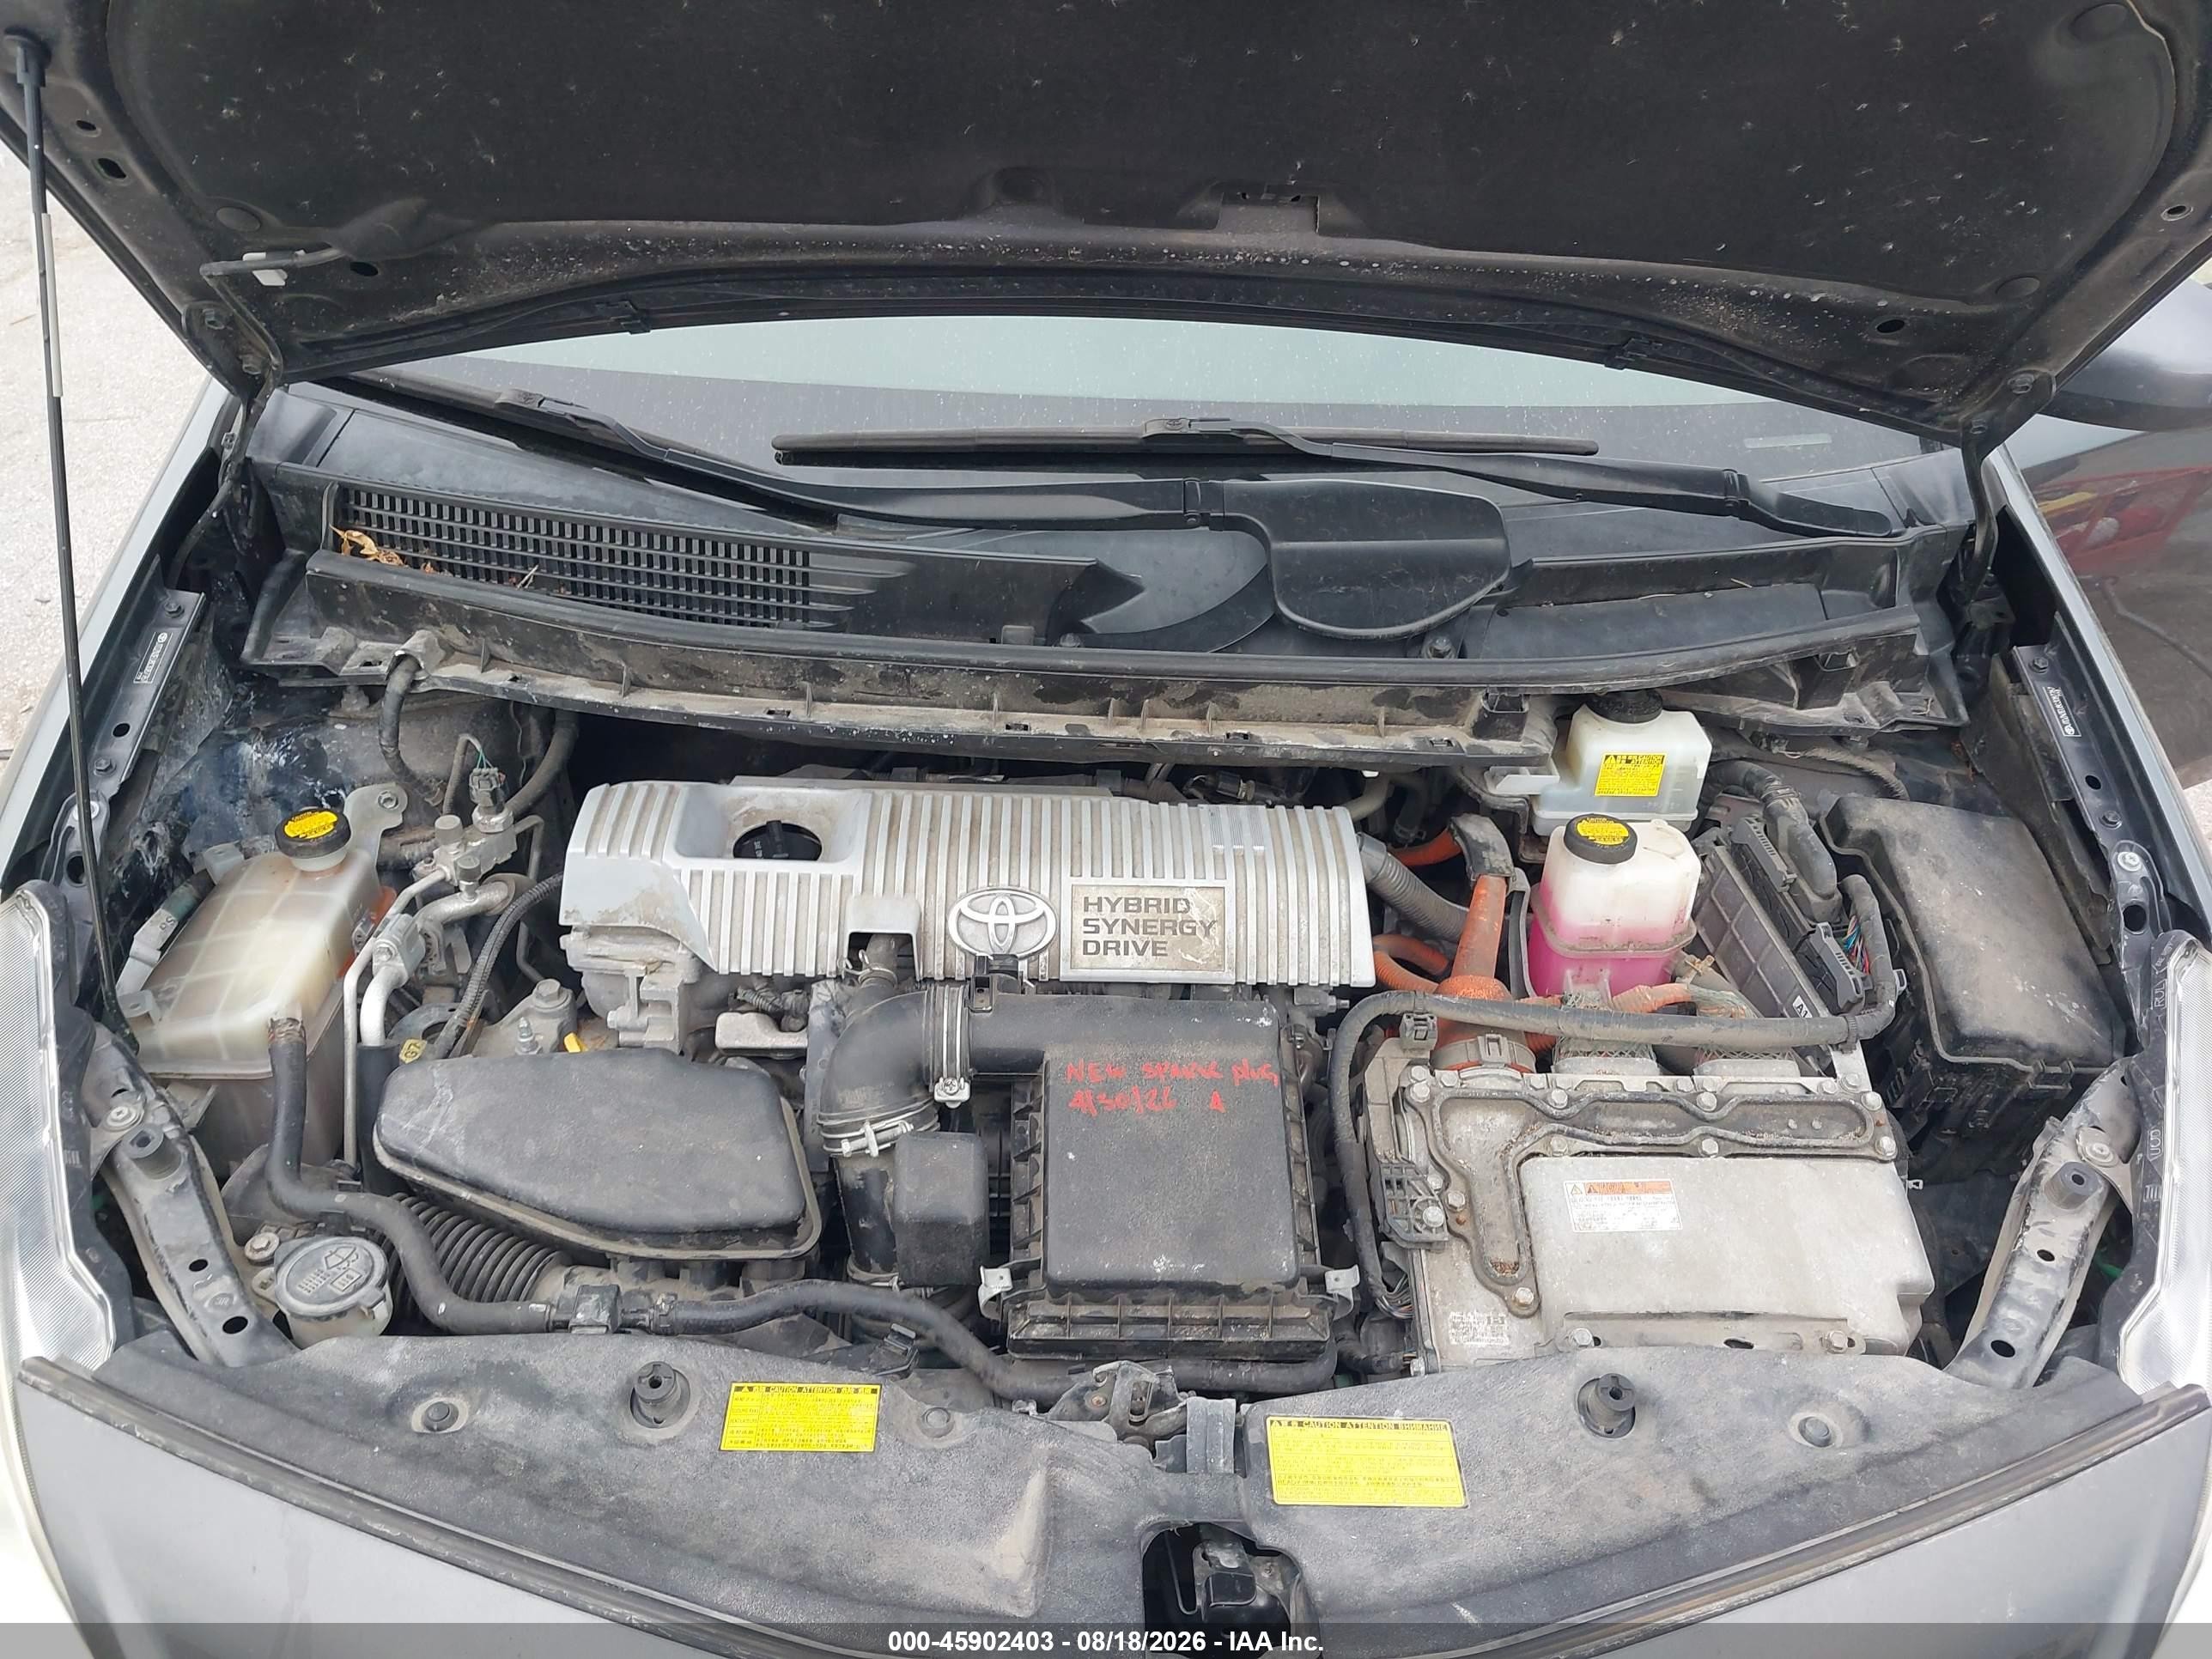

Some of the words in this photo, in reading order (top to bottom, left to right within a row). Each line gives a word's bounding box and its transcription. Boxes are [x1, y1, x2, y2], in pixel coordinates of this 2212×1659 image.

[1083, 896, 1191, 915] HYBRID
[1082, 918, 1218, 938] SYNERGY
[1082, 939, 1169, 957] DRIVE
[1303, 1420, 1342, 1429] CAUTION
[1346, 1421, 1395, 1430] ATTENTION
